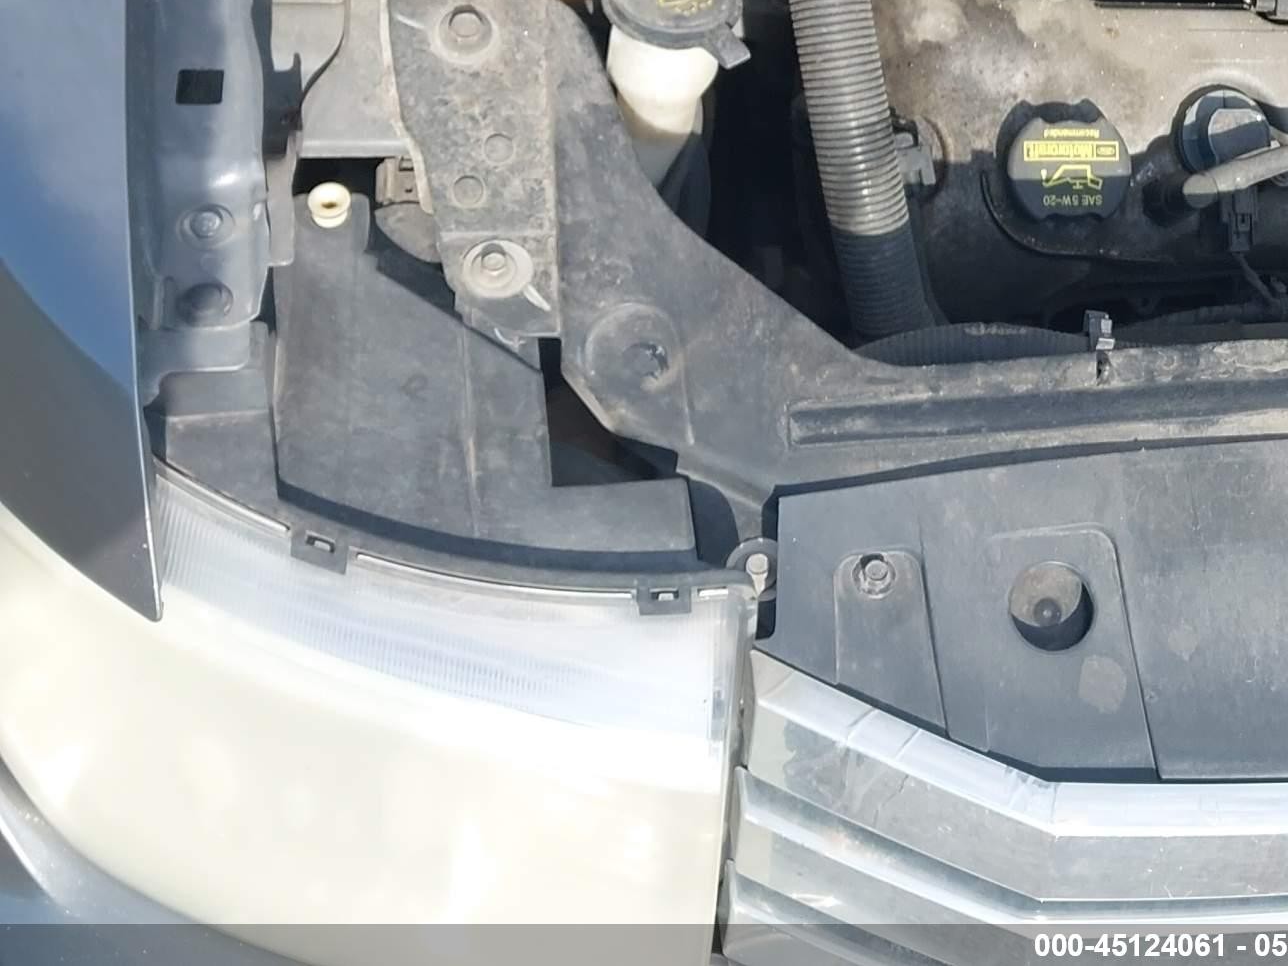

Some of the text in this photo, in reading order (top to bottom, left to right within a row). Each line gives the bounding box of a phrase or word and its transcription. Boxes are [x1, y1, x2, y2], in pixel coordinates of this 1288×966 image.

[1027, 143, 1093, 159] Motorcraft
[1043, 194, 1103, 206] SAE 5W-20
